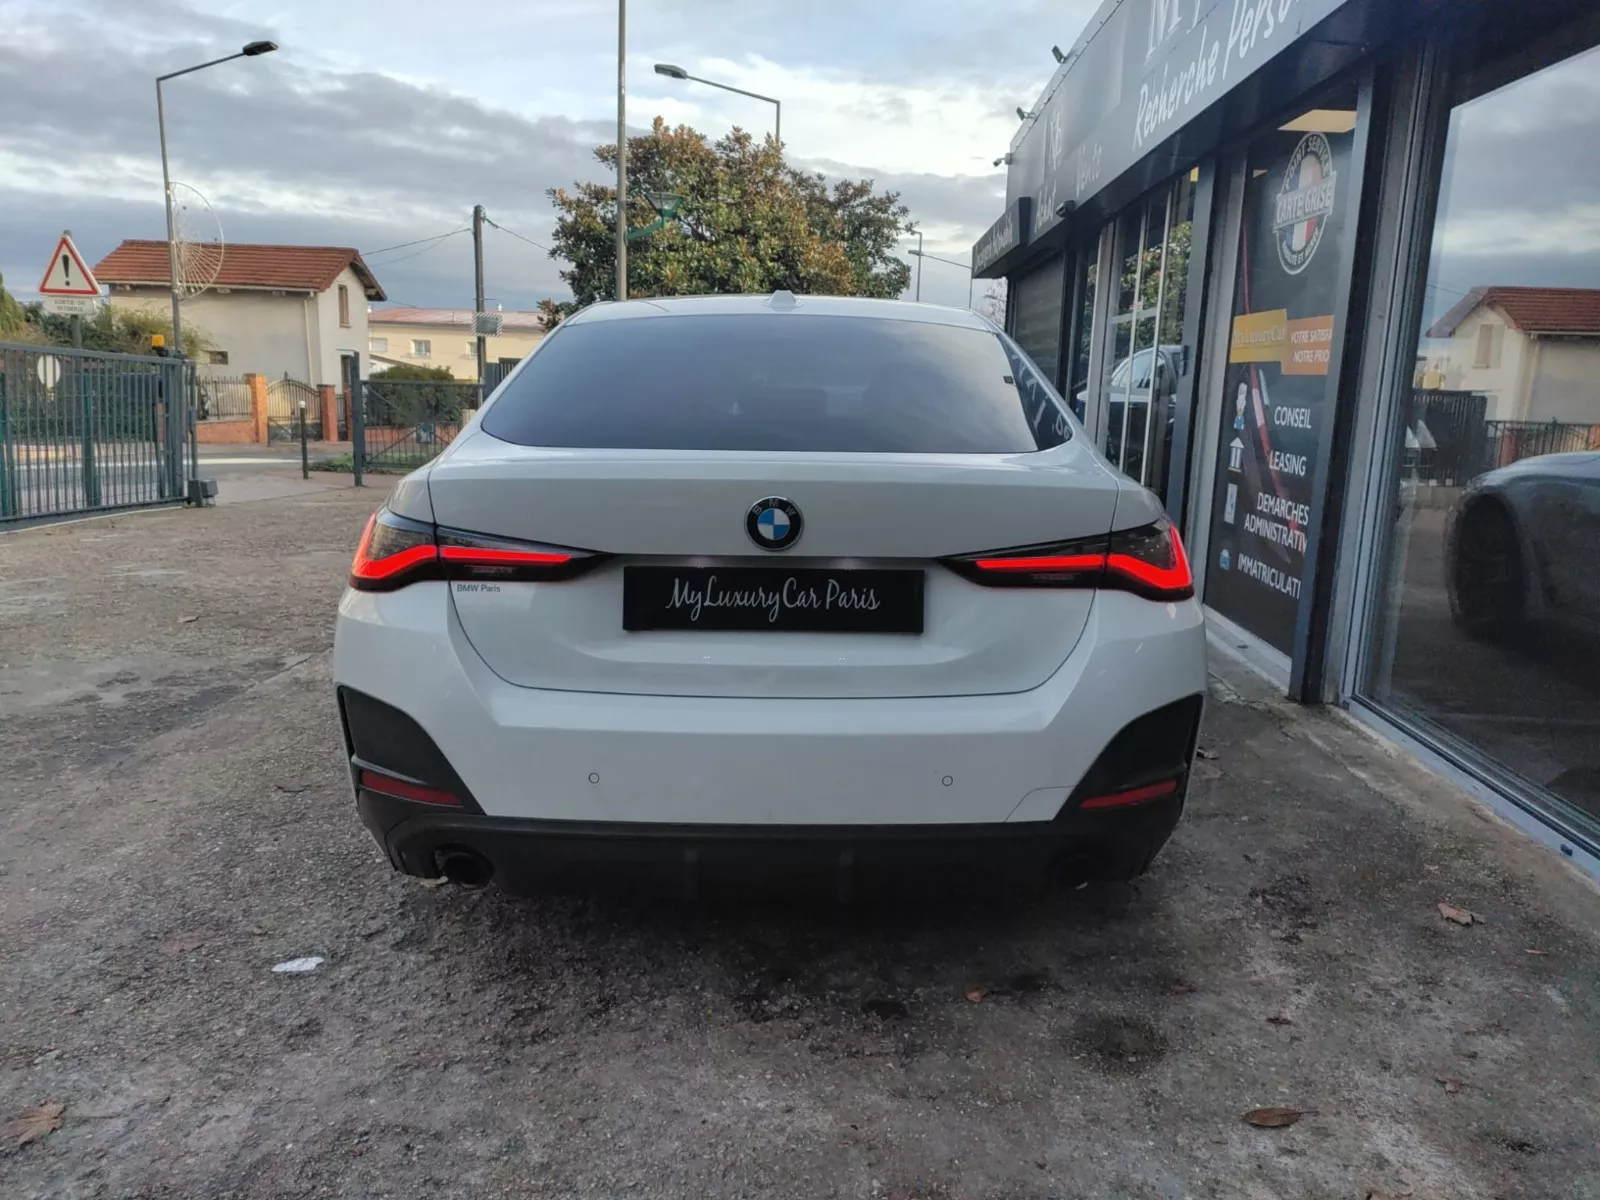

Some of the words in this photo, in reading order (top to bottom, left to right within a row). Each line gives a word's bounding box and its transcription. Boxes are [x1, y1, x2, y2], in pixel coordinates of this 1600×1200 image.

[1133, 25, 1219, 152] Recherche
[1307, 135, 1331, 178] SERVICE
[1276, 191, 1304, 224] CARTE
[1304, 179, 1334, 214] GRISE
[1290, 330, 1309, 344] VOTRE
[1293, 349, 1313, 363] NOTRE
[1274, 406, 1311, 429] CONSEIL
[1268, 450, 1306, 476] LEASING
[752, 498, 797, 517] BMW
[1257, 492, 1309, 526] DEMARCHES
[456, 583, 479, 592] BMW
[480, 583, 501, 592] Paris
[1237, 552, 1301, 600] IMMATRICULATI
[826, 578, 880, 610] Paris
